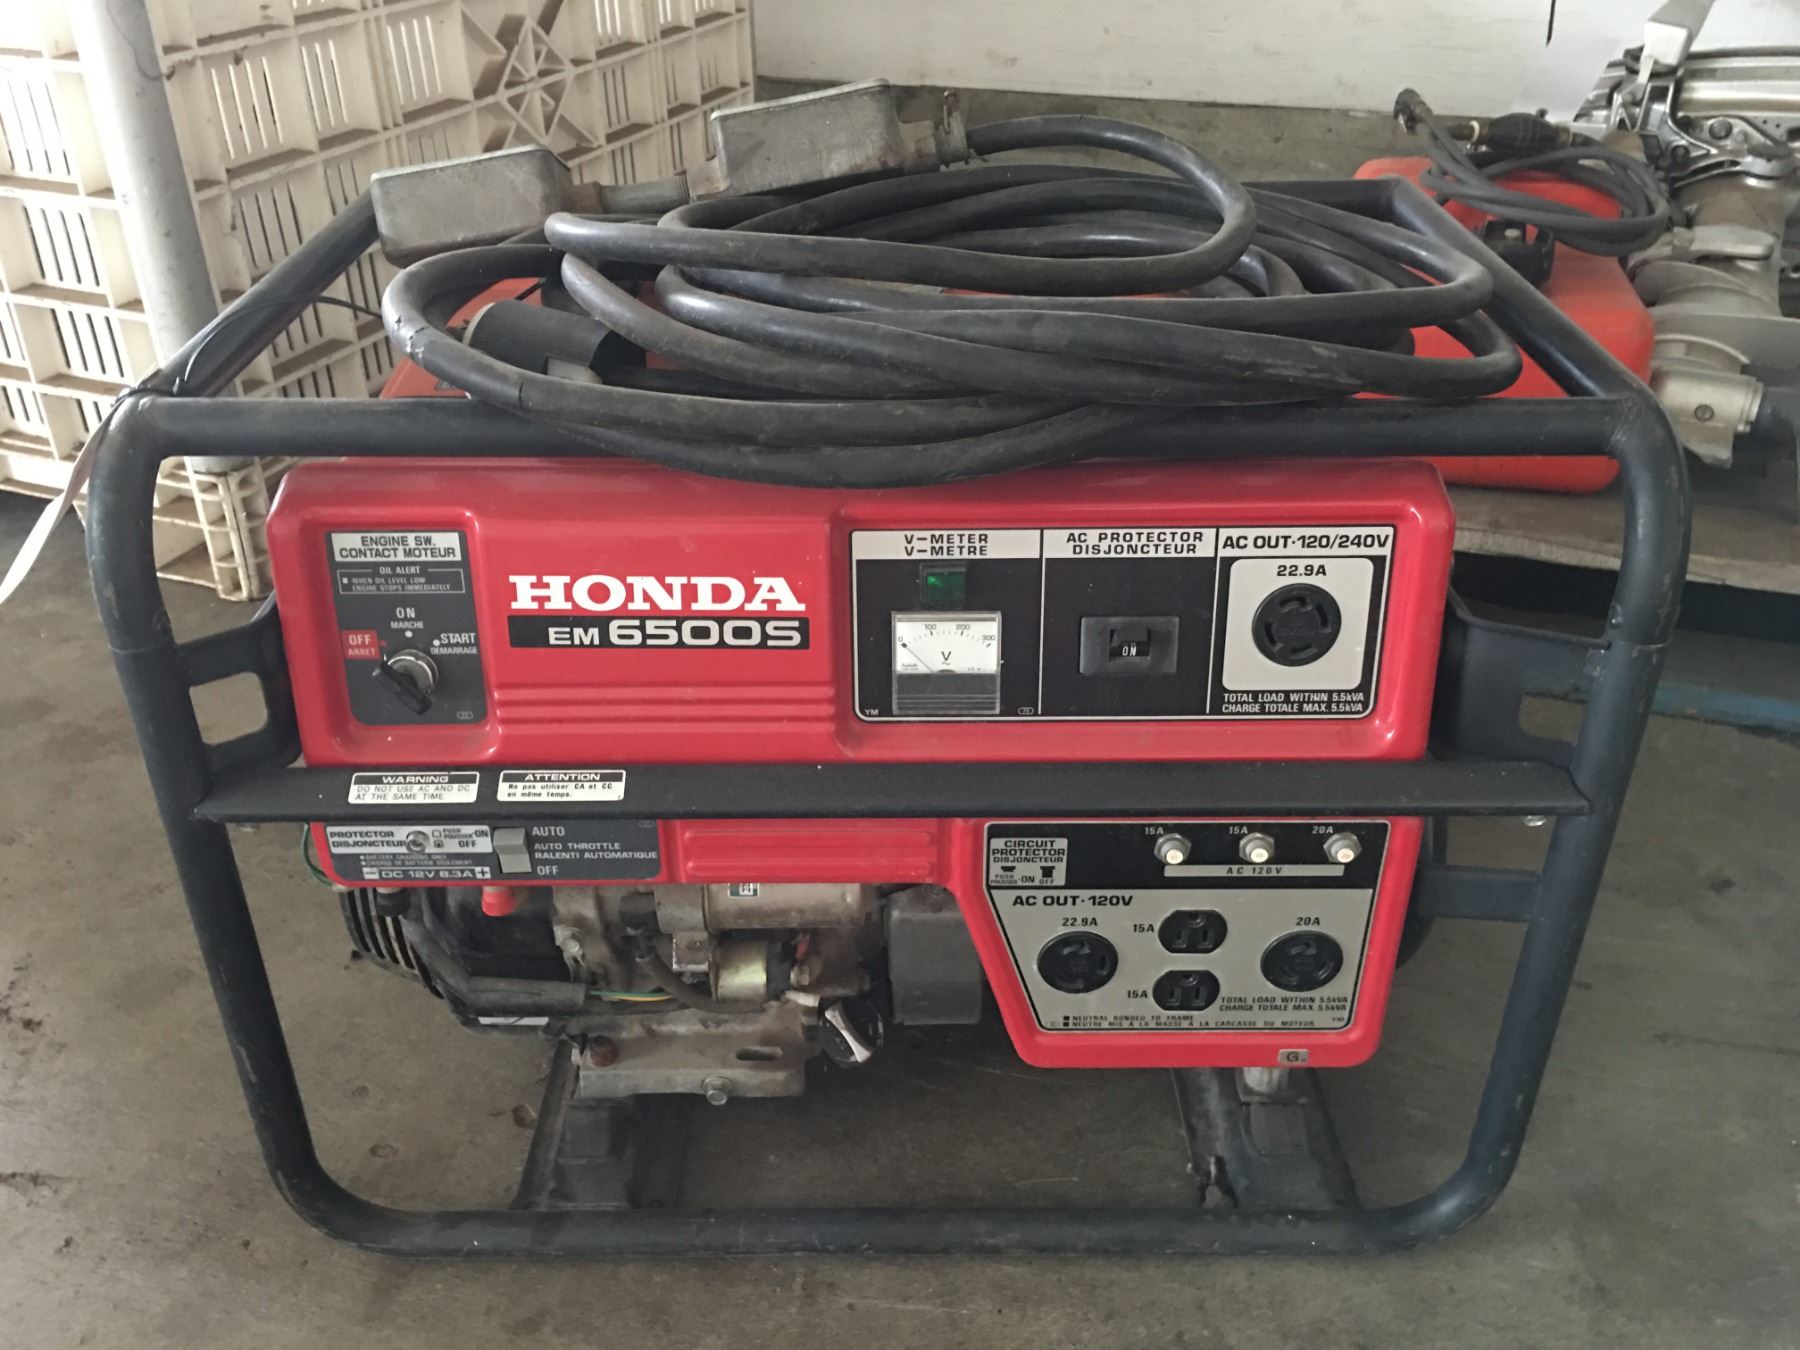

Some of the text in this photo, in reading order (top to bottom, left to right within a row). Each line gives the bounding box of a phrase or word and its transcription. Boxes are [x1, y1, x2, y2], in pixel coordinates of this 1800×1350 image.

[361, 535, 435, 546] ENGINE SW.
[904, 534, 988, 544] V-METER
[1066, 532, 1204, 543] AC PROTECTOR
[1222, 536, 1248, 549] AC
[339, 547, 456, 559] CONTACT MOTEUR
[904, 546, 988, 556] V-METRE
[1072, 544, 1197, 555] DISJONCTEUR
[379, 566, 420, 575] OIL ALERT
[1276, 565, 1327, 576] 22.9A
[352, 583, 451, 592] ENGINE STOPS IMMEDIATELY
[508, 574, 806, 612] HONDA
[396, 607, 415, 619] ON
[390, 621, 424, 629] MARCHE
[548, 619, 801, 647] EM 6500S
[348, 634, 372, 646] OFF
[440, 633, 476, 644] START
[941, 651, 951, 661] V
[1122, 647, 1137, 656] ON
[1224, 693, 1365, 702] TOTAL LOAD WITHIN 5.5kVA
[1222, 703, 1363, 713] CHARGE TOTALE MAX. 5.5kVA
[525, 773, 601, 781] ATTENTION
[532, 826, 565, 837] AUTO
[1145, 827, 1164, 835] 15A
[1312, 826, 1334, 834] 20A
[330, 831, 394, 839] PROTECTOR
[332, 840, 407, 848] DISJONCTEUR
[458, 840, 476, 848] OFF
[1004, 840, 1056, 848] CIRCUIT
[583, 851, 658, 859] AUTOMATIQUE
[992, 848, 1066, 856] PROTECTOR
[381, 870, 403, 878] DC
[408, 870, 435, 878] 12V
[536, 865, 559, 875] OFF
[1226, 867, 1283, 875] AC 120V
[1013, 896, 1036, 906] AC
[1062, 917, 1098, 926] 22.9A
[1296, 917, 1321, 926] 20A
[1133, 924, 1154, 932] 15A
[1127, 990, 1148, 999] 15A
[1286, 1052, 1299, 1062] G
